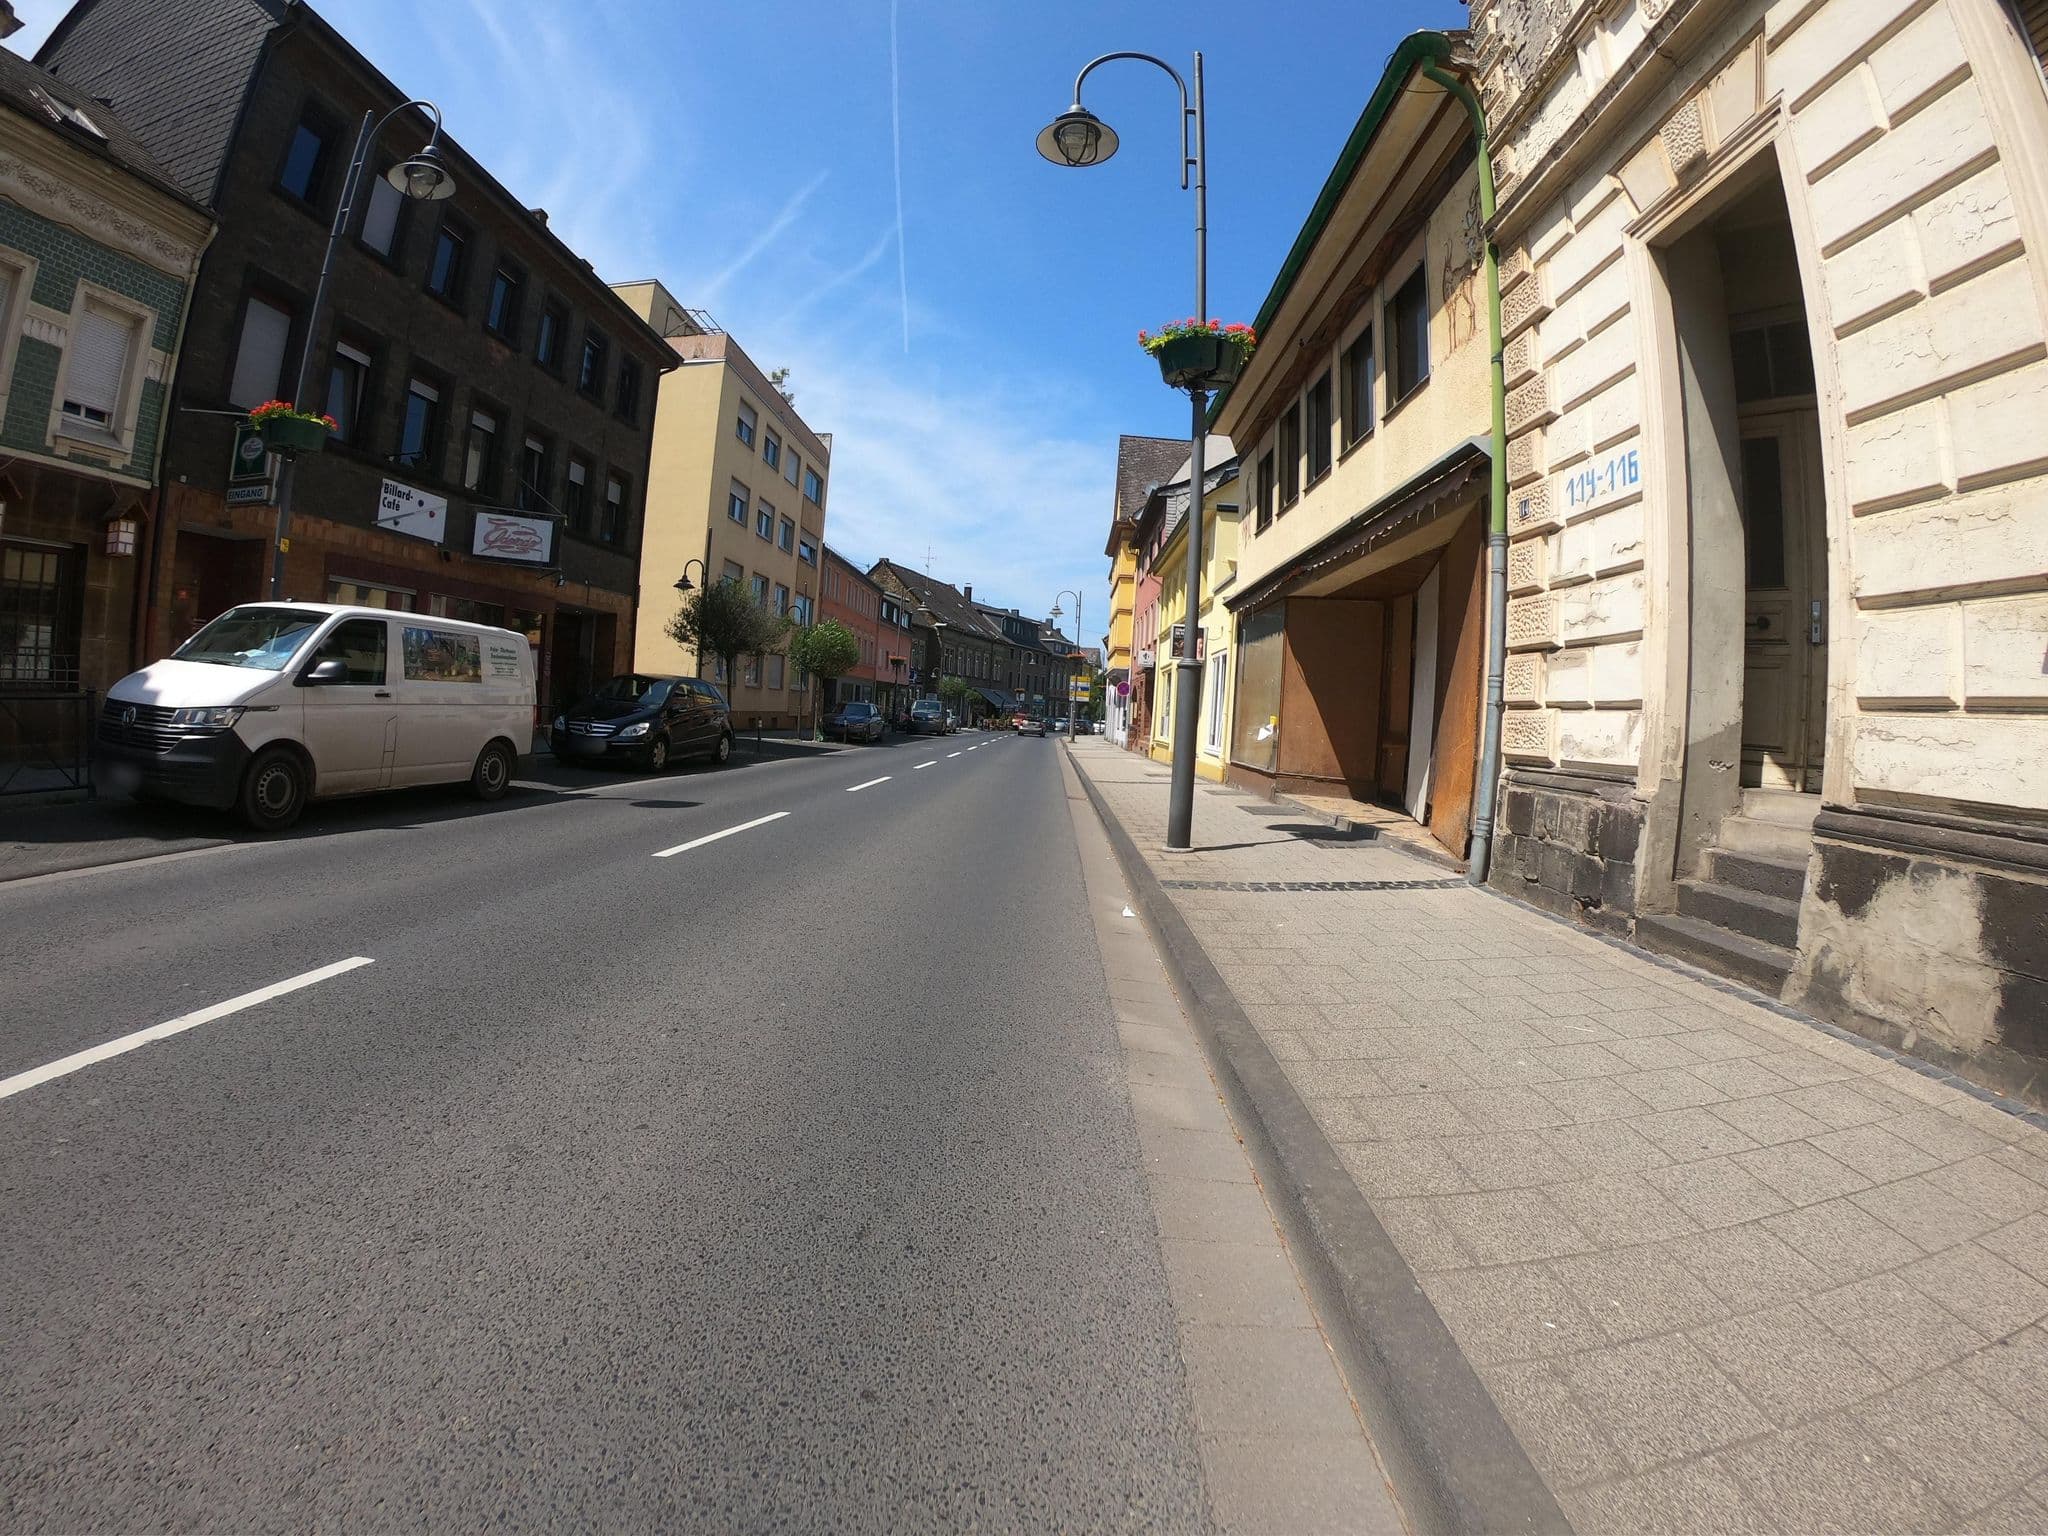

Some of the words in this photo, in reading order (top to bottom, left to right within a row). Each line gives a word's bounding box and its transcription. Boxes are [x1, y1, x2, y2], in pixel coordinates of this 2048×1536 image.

[1566, 450, 1639, 506] 114-116
[228, 488, 263, 500] EINGANG
[384, 483, 413, 501] Billard-
[382, 496, 401, 512] Café
